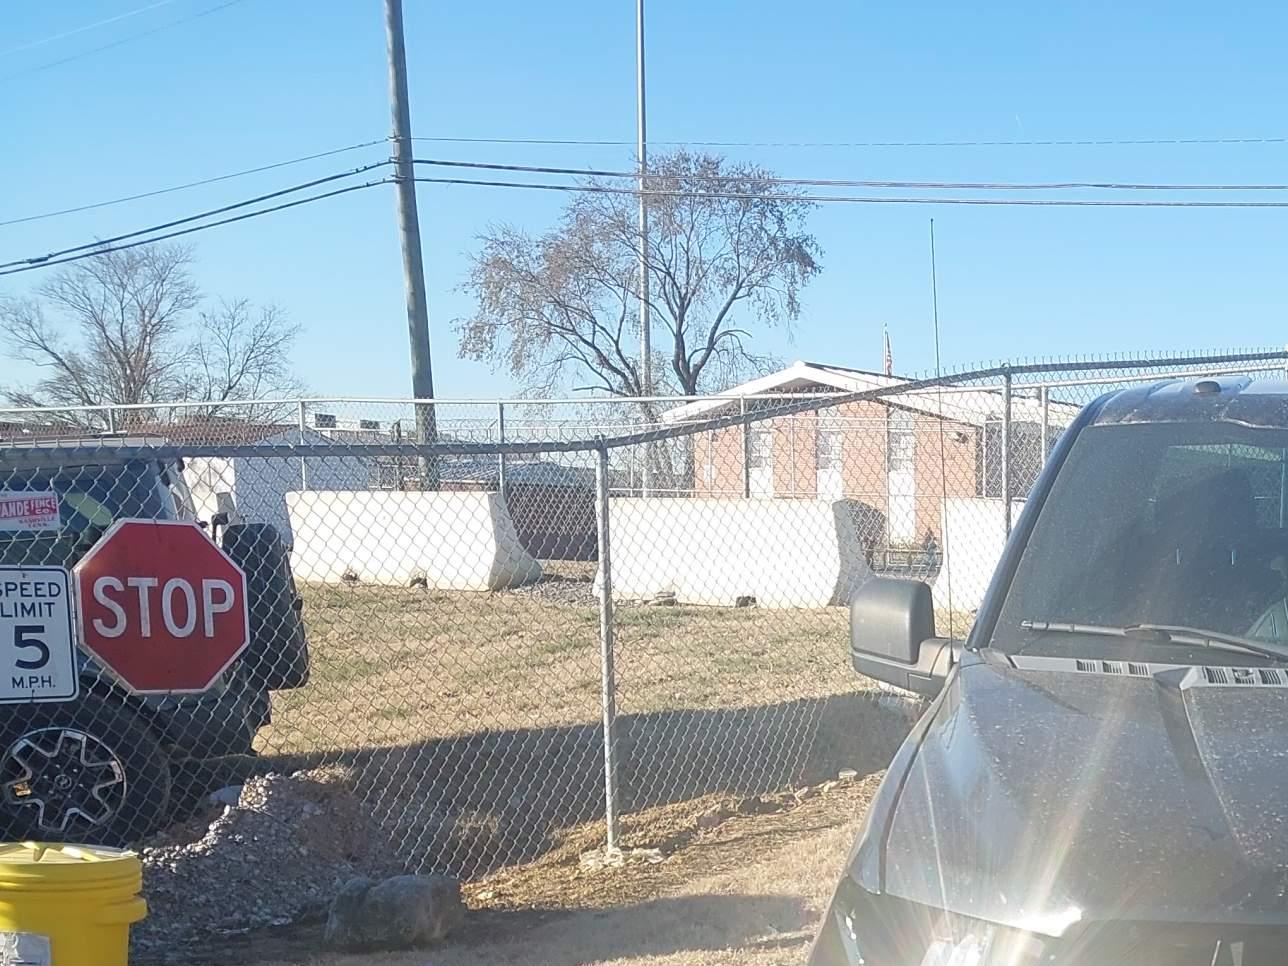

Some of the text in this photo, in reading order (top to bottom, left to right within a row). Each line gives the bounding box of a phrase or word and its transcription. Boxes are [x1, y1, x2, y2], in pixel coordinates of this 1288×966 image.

[0, 498, 56, 518] ANDE FENCE
[0, 582, 61, 598] PEED
[0, 602, 55, 618] LIMIT
[93, 576, 235, 638] STOP
[14, 625, 50, 670] 5
[12, 675, 56, 689] M.P.H.
